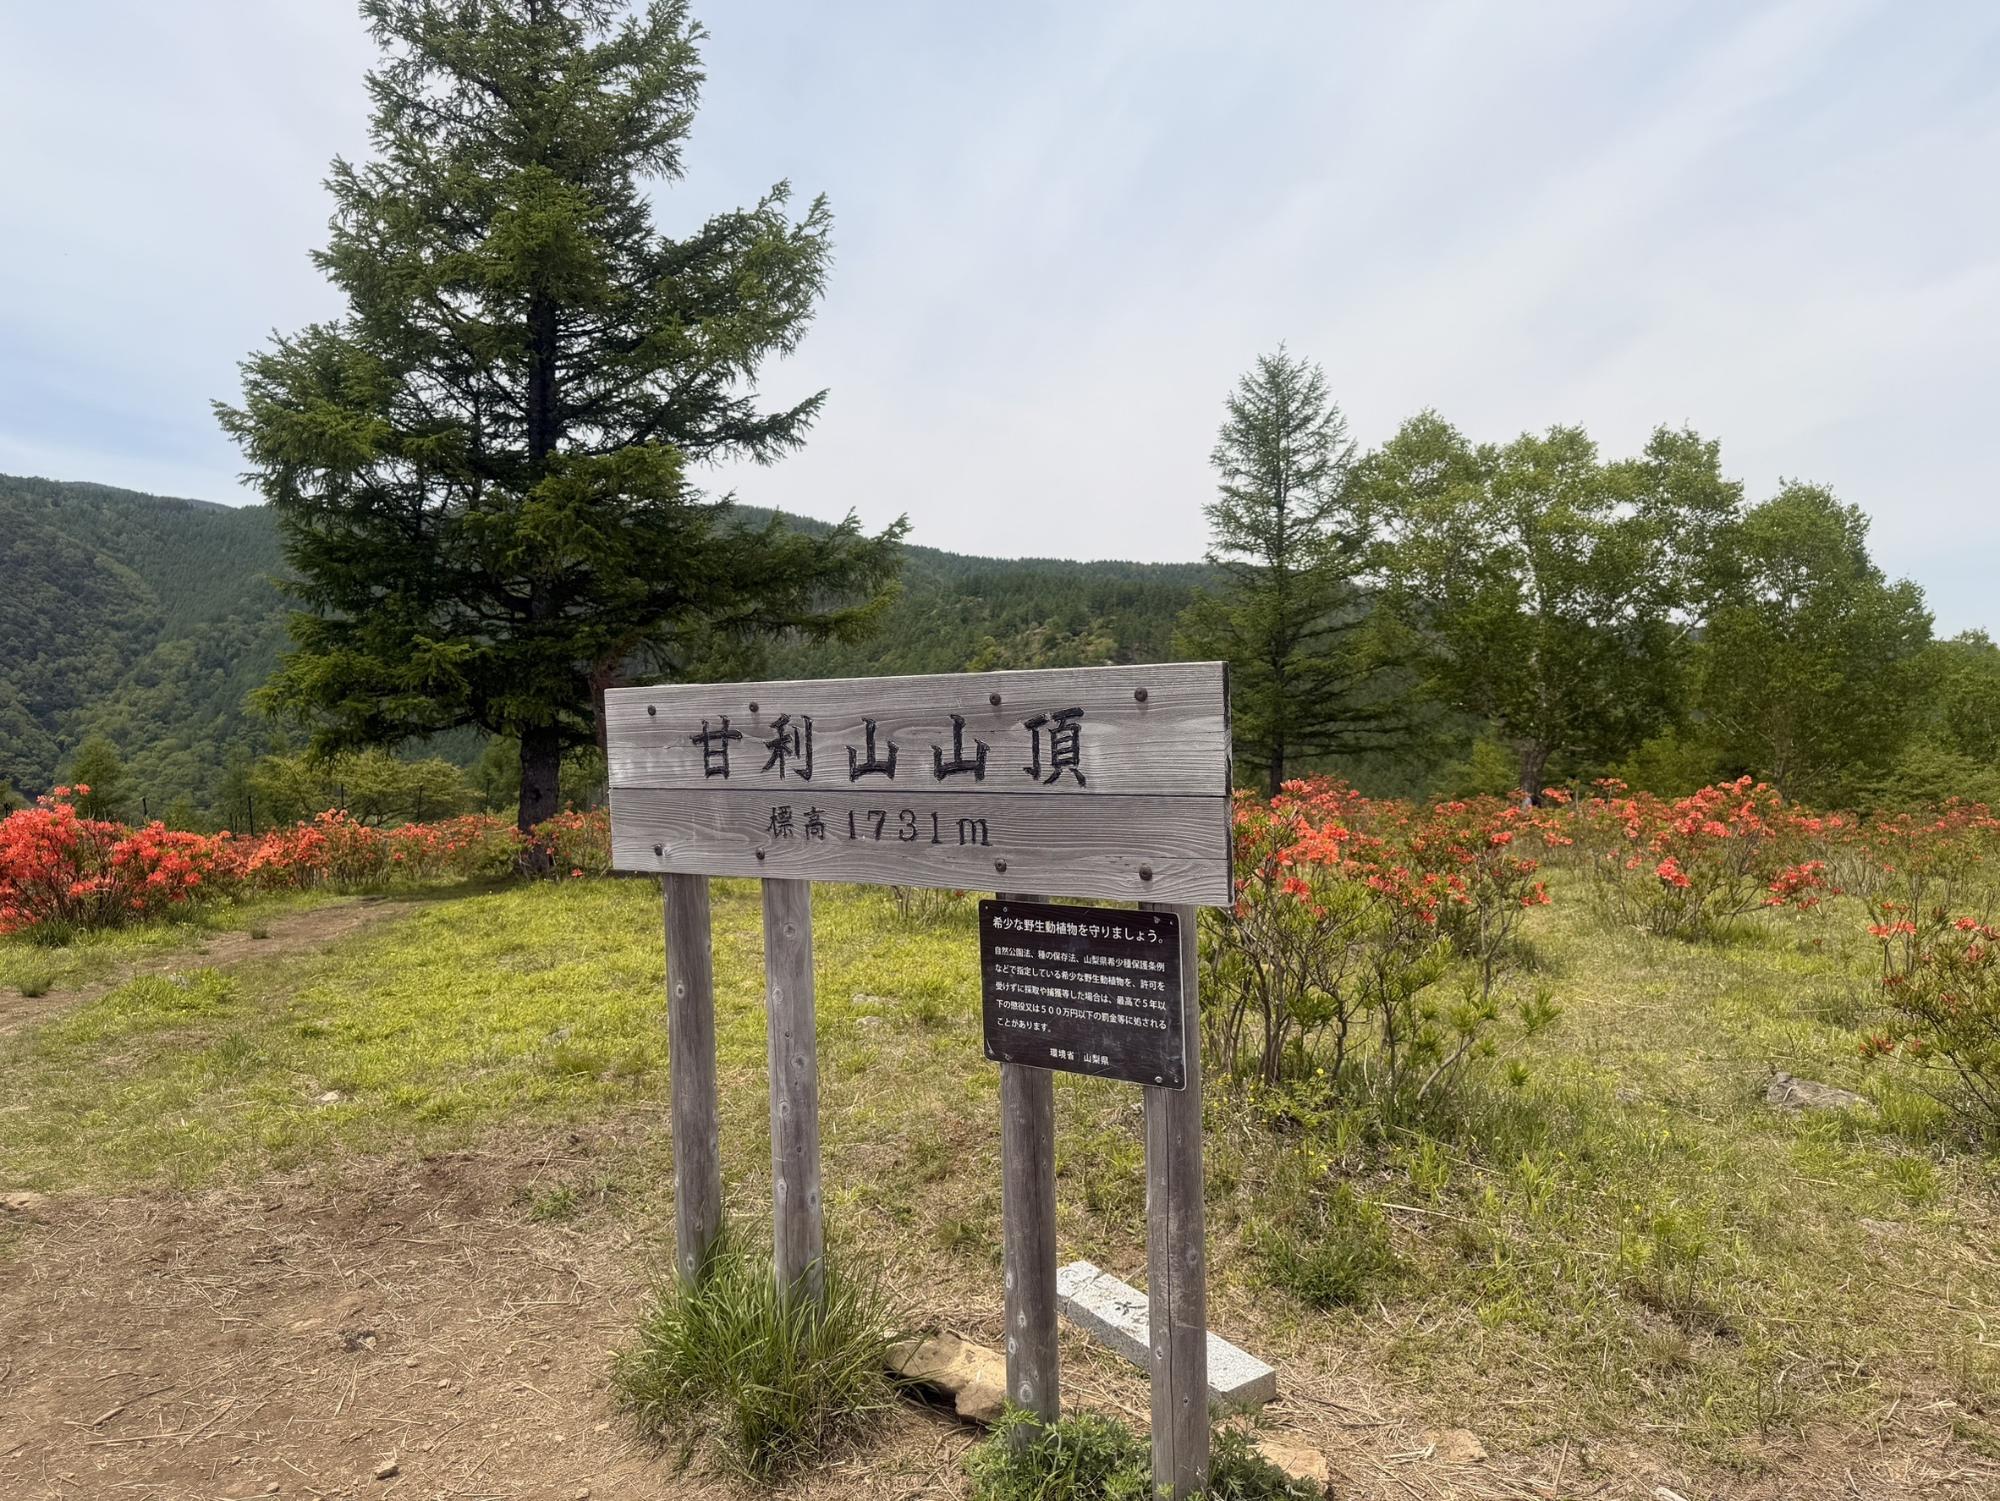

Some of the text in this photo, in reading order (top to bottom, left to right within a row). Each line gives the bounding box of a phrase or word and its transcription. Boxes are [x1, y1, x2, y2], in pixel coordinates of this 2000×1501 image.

[690, 706, 1087, 788] 甘利山山頂
[1084, 1053, 1109, 1066] 山梨県
